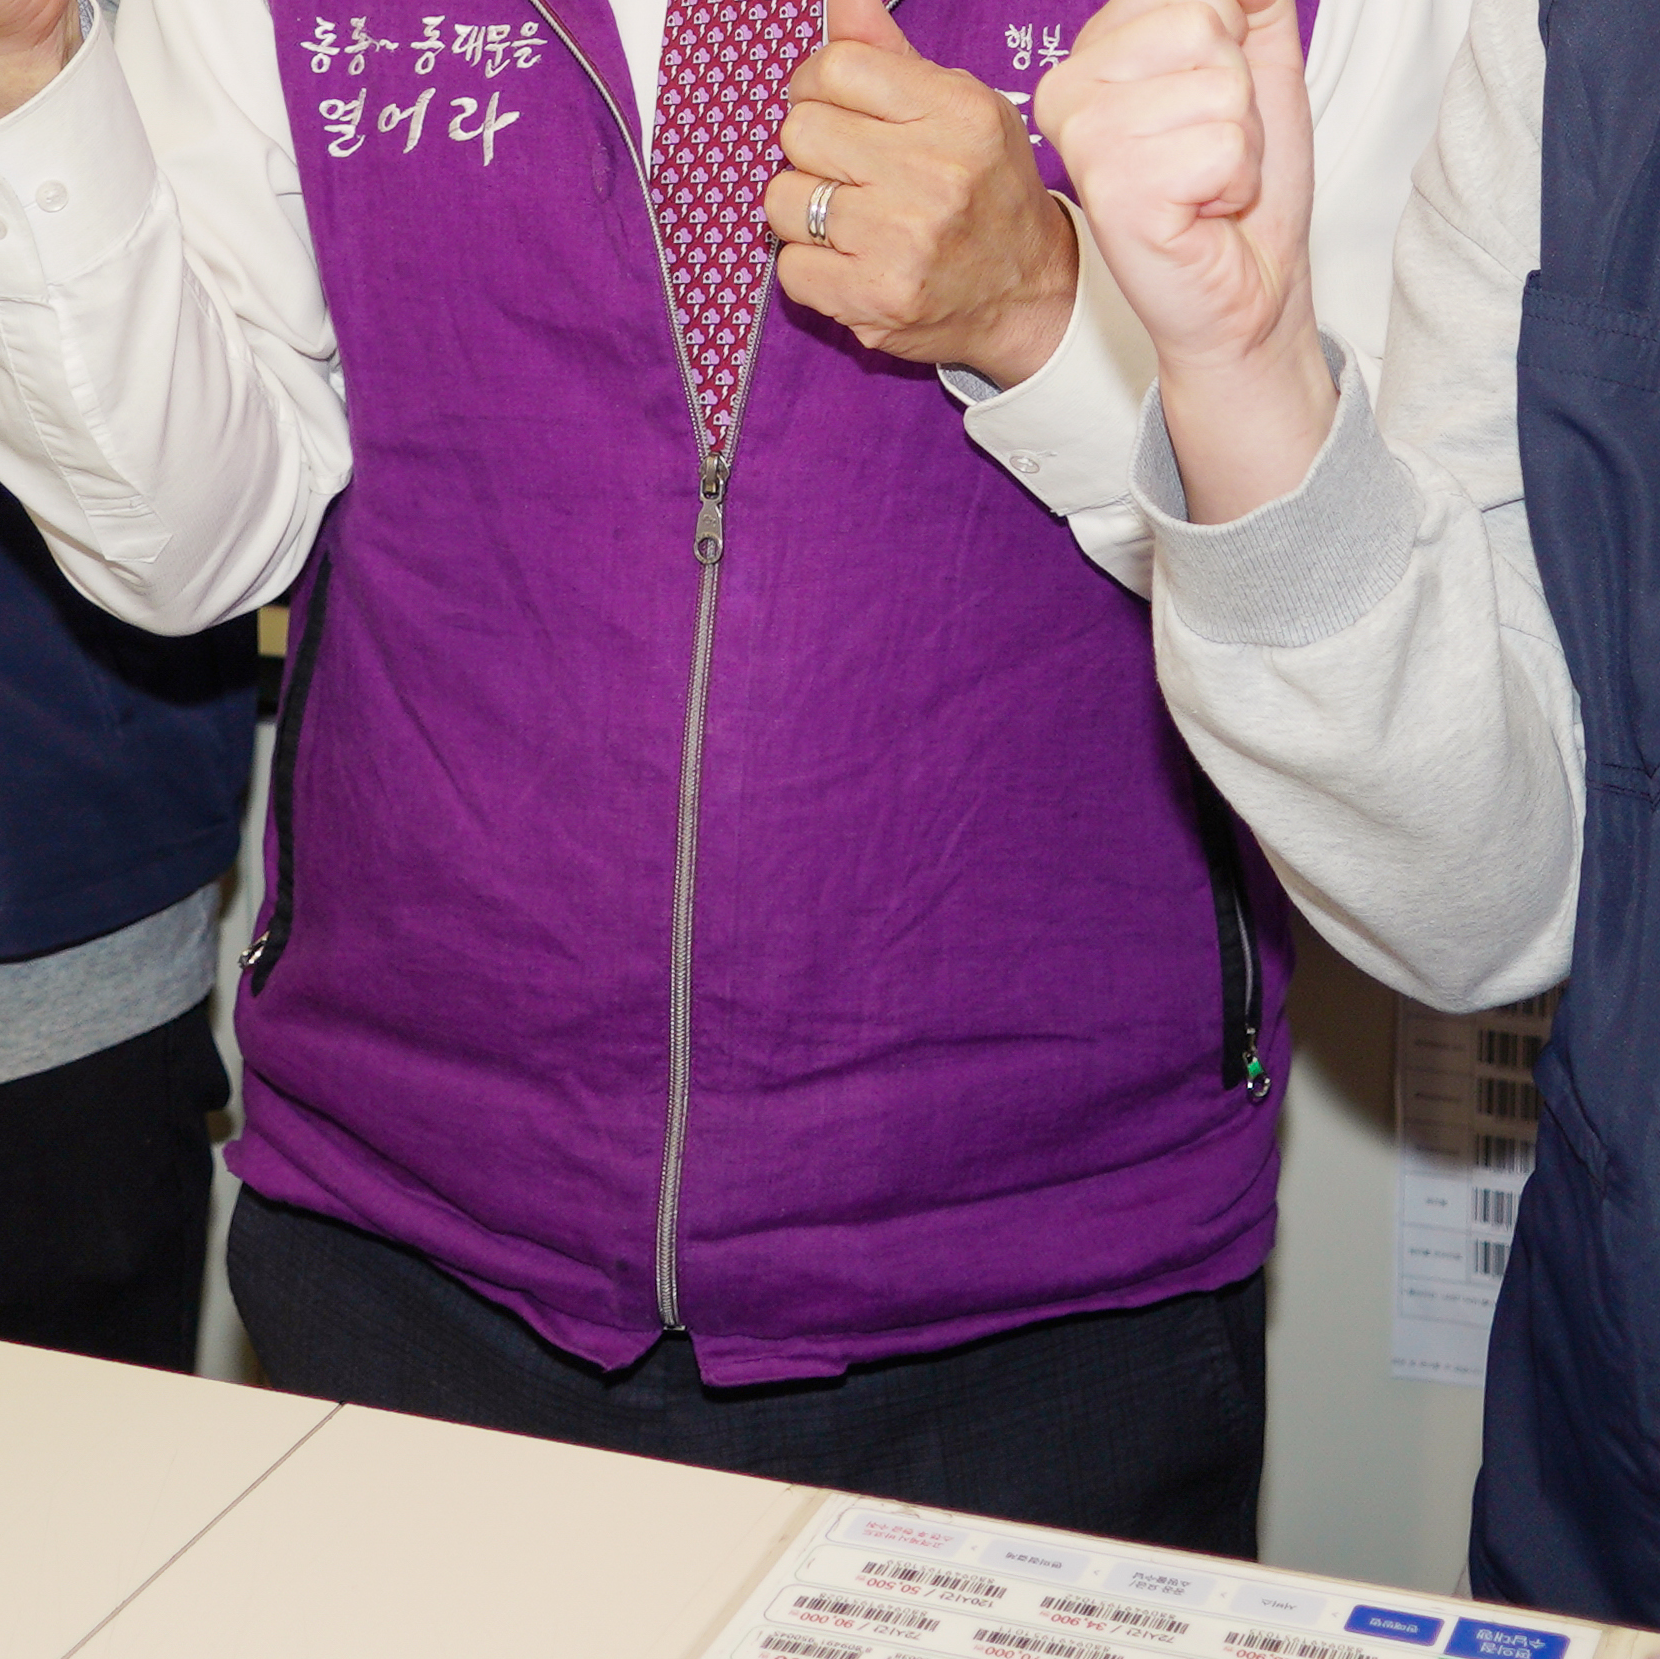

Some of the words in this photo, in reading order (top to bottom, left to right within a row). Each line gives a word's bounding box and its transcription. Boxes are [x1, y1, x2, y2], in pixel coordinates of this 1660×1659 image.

[408, 14, 548, 80] 동대문을
[316, 89, 521, 168] 열어라
[938, 1590, 995, 1609] 120시간
[871, 1624, 923, 1642] 72시간
[1125, 1626, 1175, 1644] 72시간
